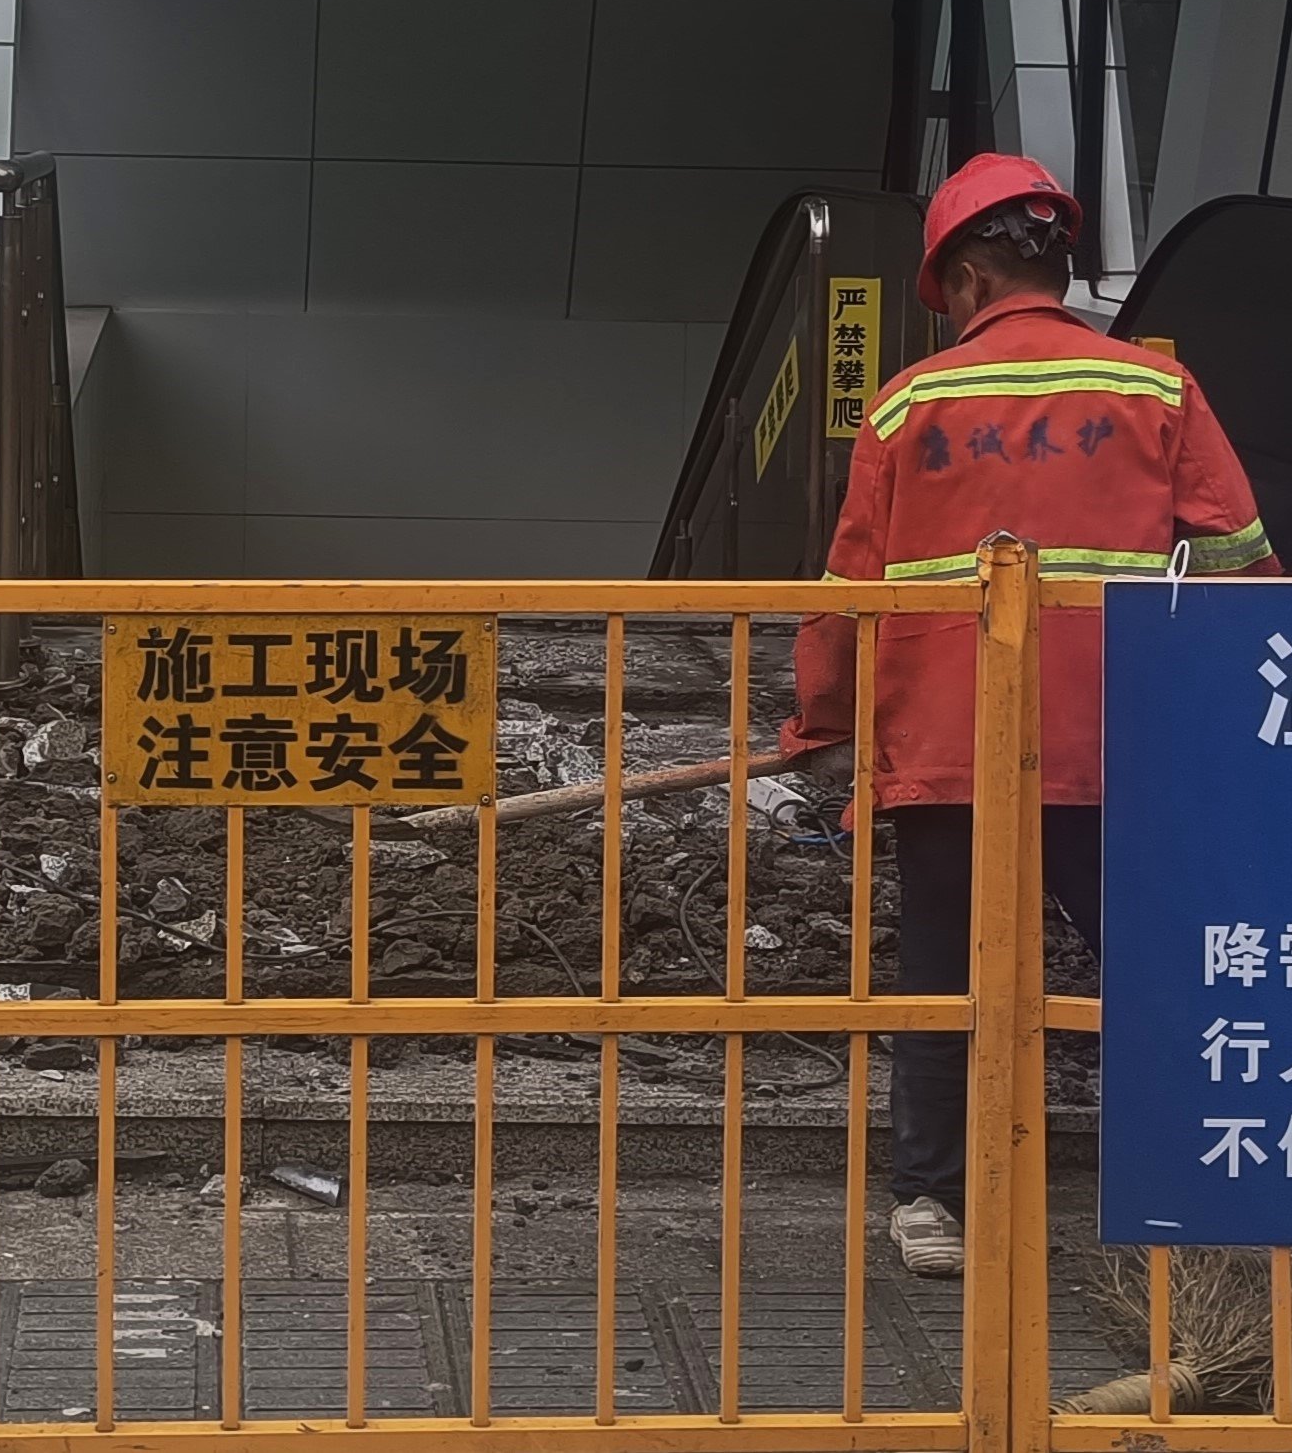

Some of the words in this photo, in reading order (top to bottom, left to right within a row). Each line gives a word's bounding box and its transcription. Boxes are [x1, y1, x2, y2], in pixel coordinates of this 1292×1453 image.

[830, 288, 867, 428] 严禁攀爬
[136, 626, 469, 704] 施工现场
[137, 712, 469, 792] 注意安全
